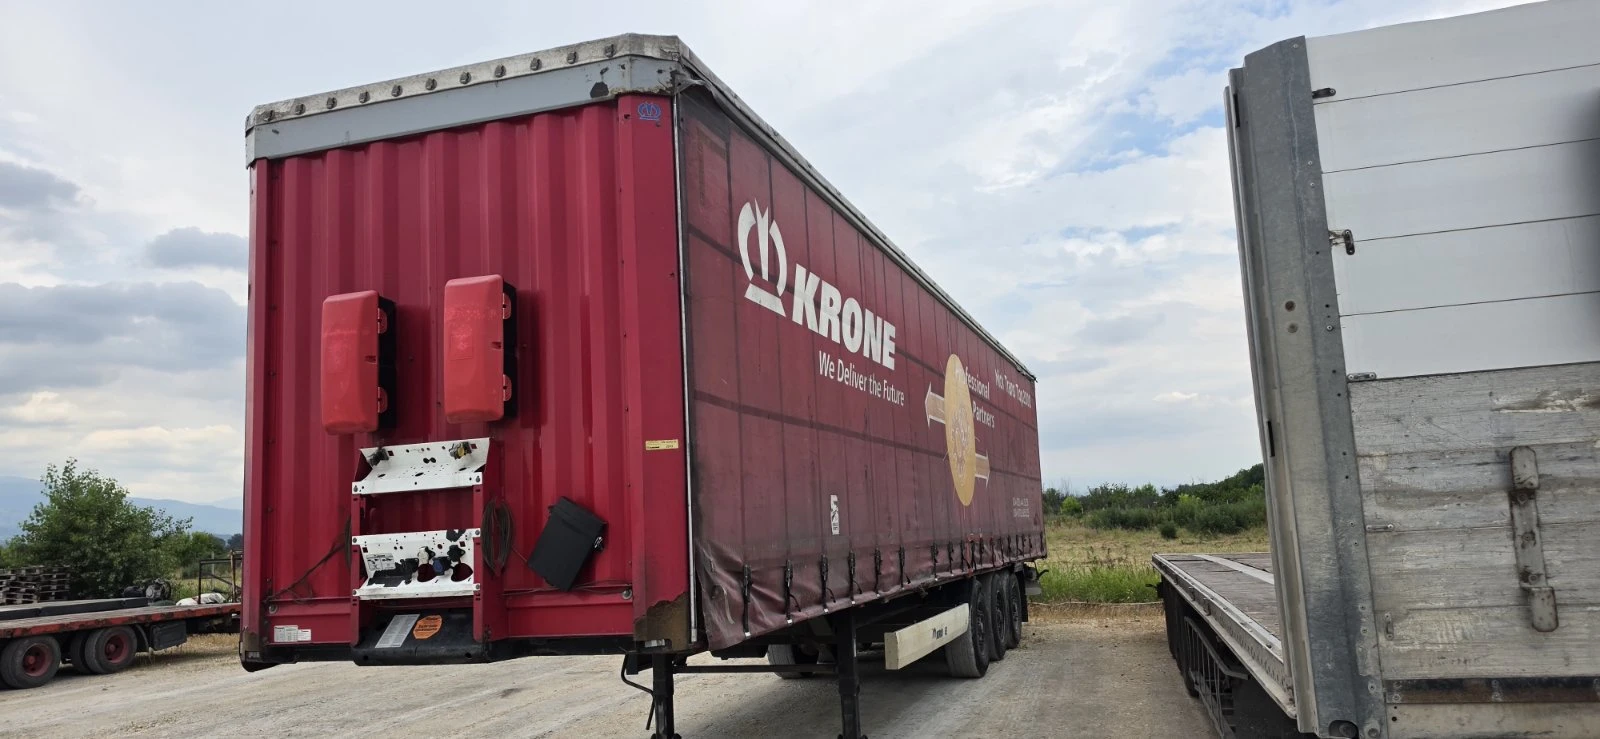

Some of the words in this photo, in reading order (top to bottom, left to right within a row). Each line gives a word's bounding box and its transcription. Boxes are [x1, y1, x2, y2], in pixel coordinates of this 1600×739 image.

[792, 263, 896, 371] KRONE
[819, 350, 835, 379] We
[837, 359, 868, 392] Deliver
[869, 375, 882, 399] the
[883, 380, 905, 407] Future
[972, 400, 995, 429] Partners
